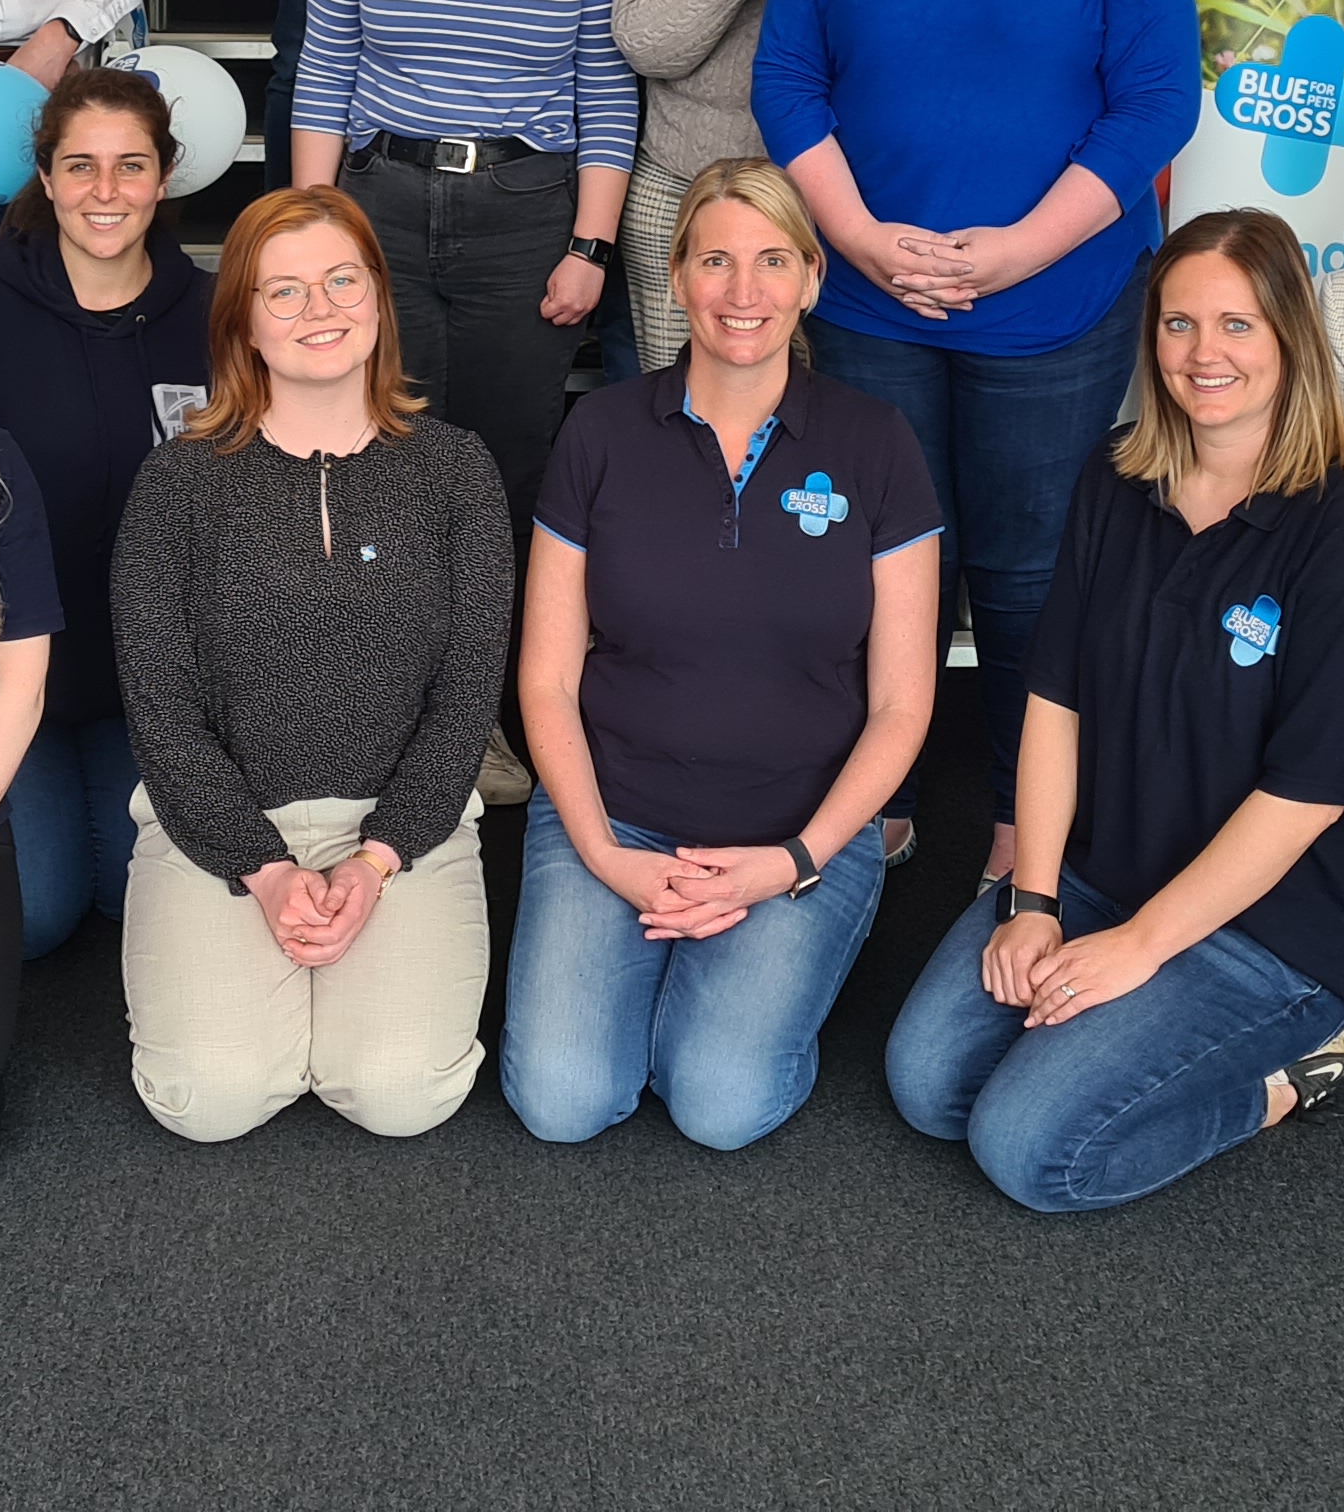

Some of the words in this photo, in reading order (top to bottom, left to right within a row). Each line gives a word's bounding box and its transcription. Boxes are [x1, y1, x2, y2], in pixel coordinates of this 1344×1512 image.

[1238, 68, 1310, 105] BLUE
[1309, 81, 1336, 97] FOR
[1306, 94, 1337, 110] PETS
[1233, 96, 1332, 137] CROSS
[788, 491, 816, 504] BLUE
[787, 501, 828, 515] CROSS
[1231, 606, 1261, 629] BLUE
[1225, 617, 1267, 647] CROSS
